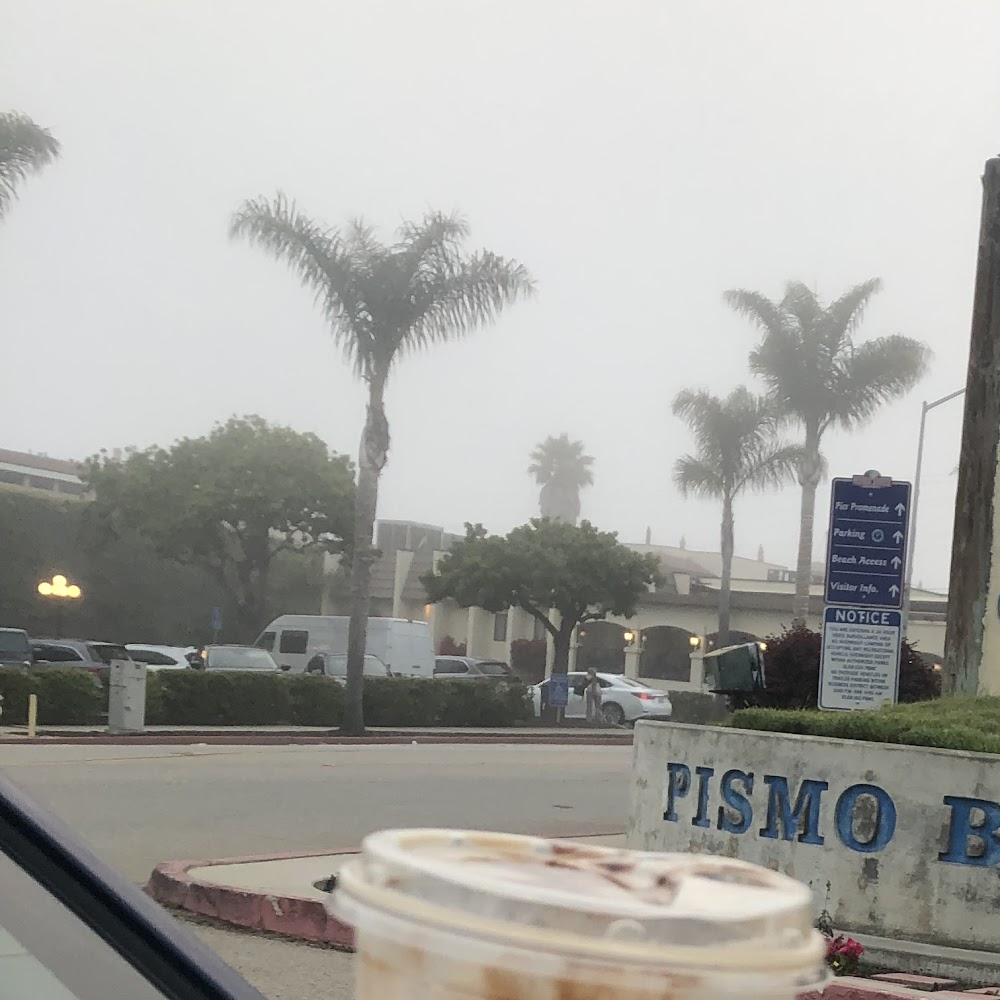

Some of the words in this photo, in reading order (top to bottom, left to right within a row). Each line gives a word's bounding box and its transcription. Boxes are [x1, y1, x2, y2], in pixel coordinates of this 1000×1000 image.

[850, 502, 890, 513] Promenade
[833, 528, 866, 540] Parking
[832, 554, 857, 564] Beach
[858, 556, 887, 566] Access
[830, 581, 858, 591] Visitor
[835, 609, 890, 624] NOTICE
[663, 762, 897, 852] PISMO
